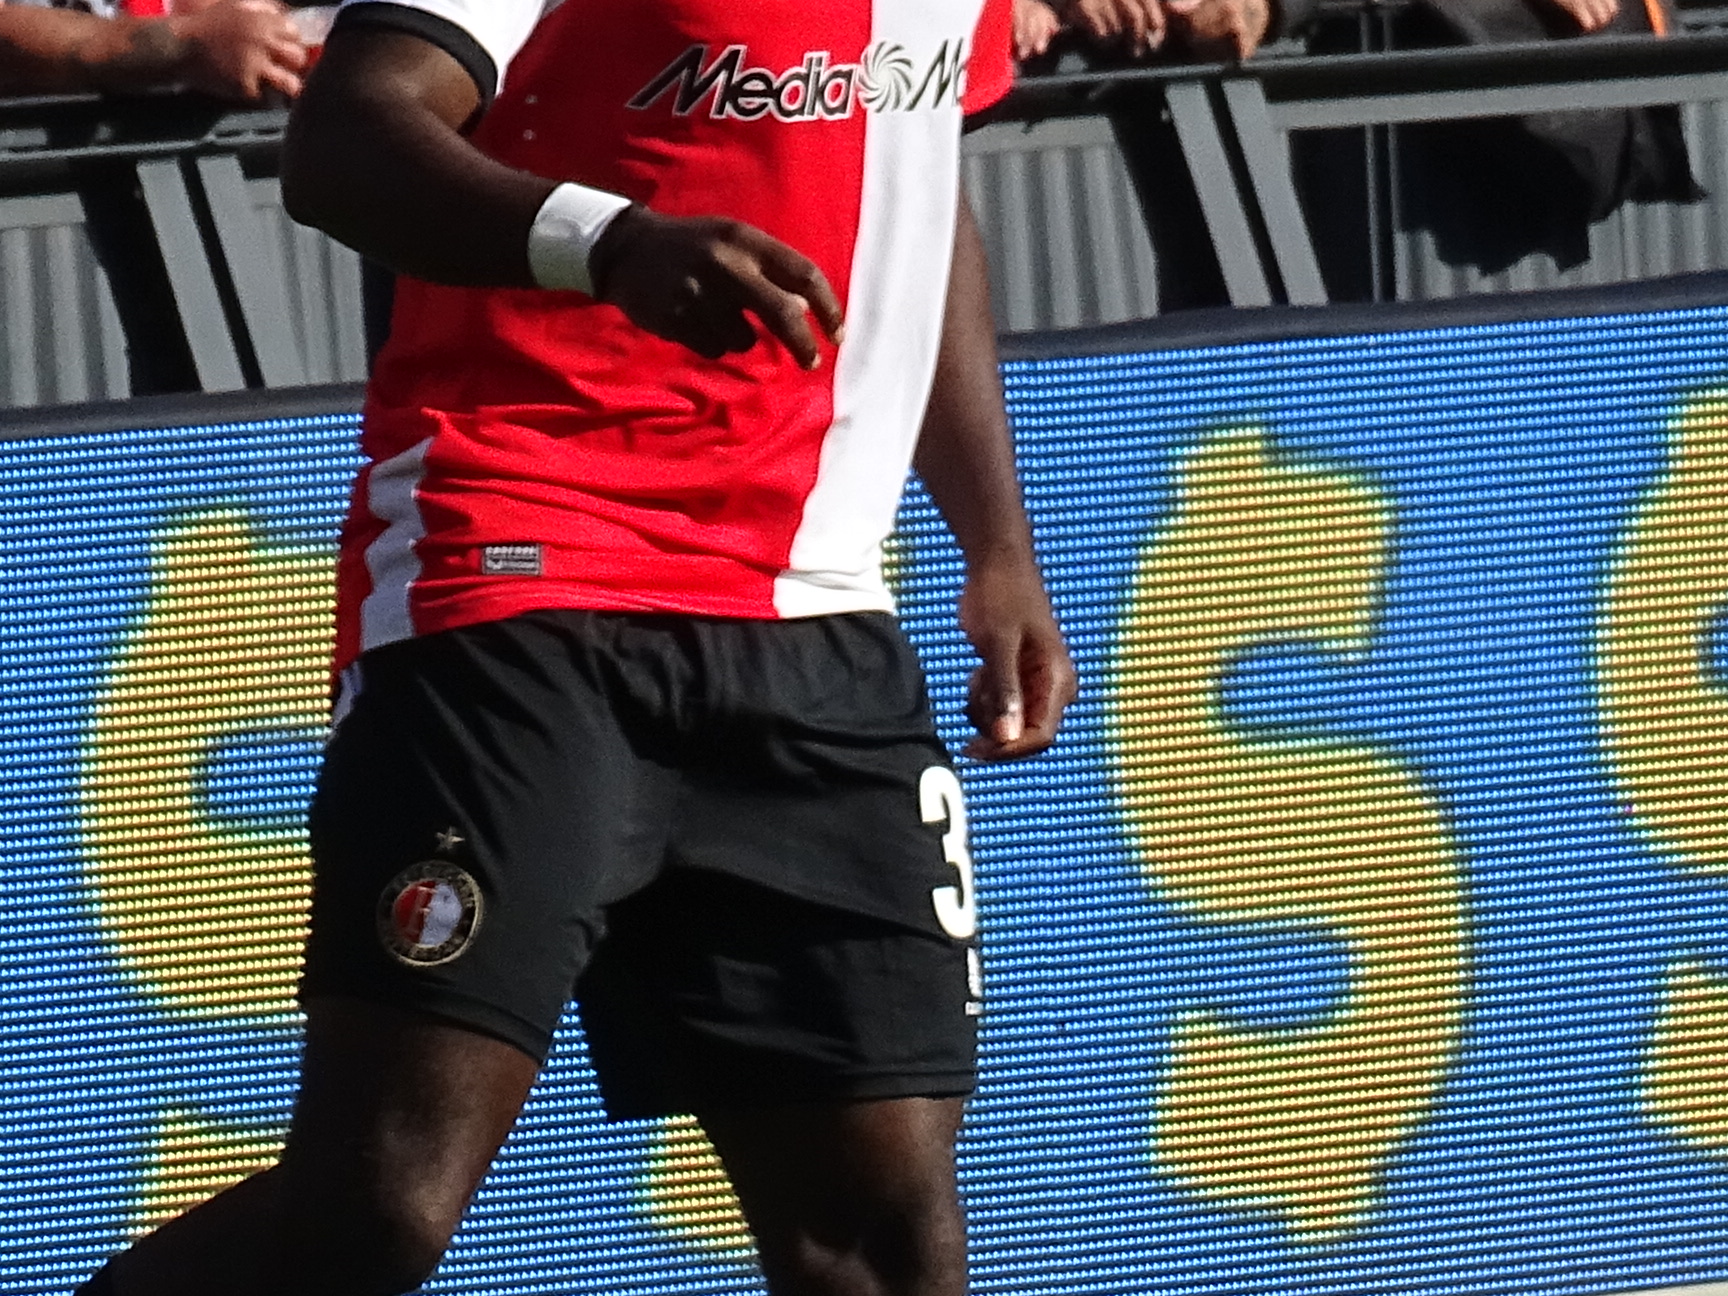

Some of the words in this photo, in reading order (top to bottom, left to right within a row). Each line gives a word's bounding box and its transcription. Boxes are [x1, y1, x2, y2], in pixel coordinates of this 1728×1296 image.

[625, 44, 858, 122] Media
[906, 37, 965, 112] M
[919, 765, 975, 938] 3
